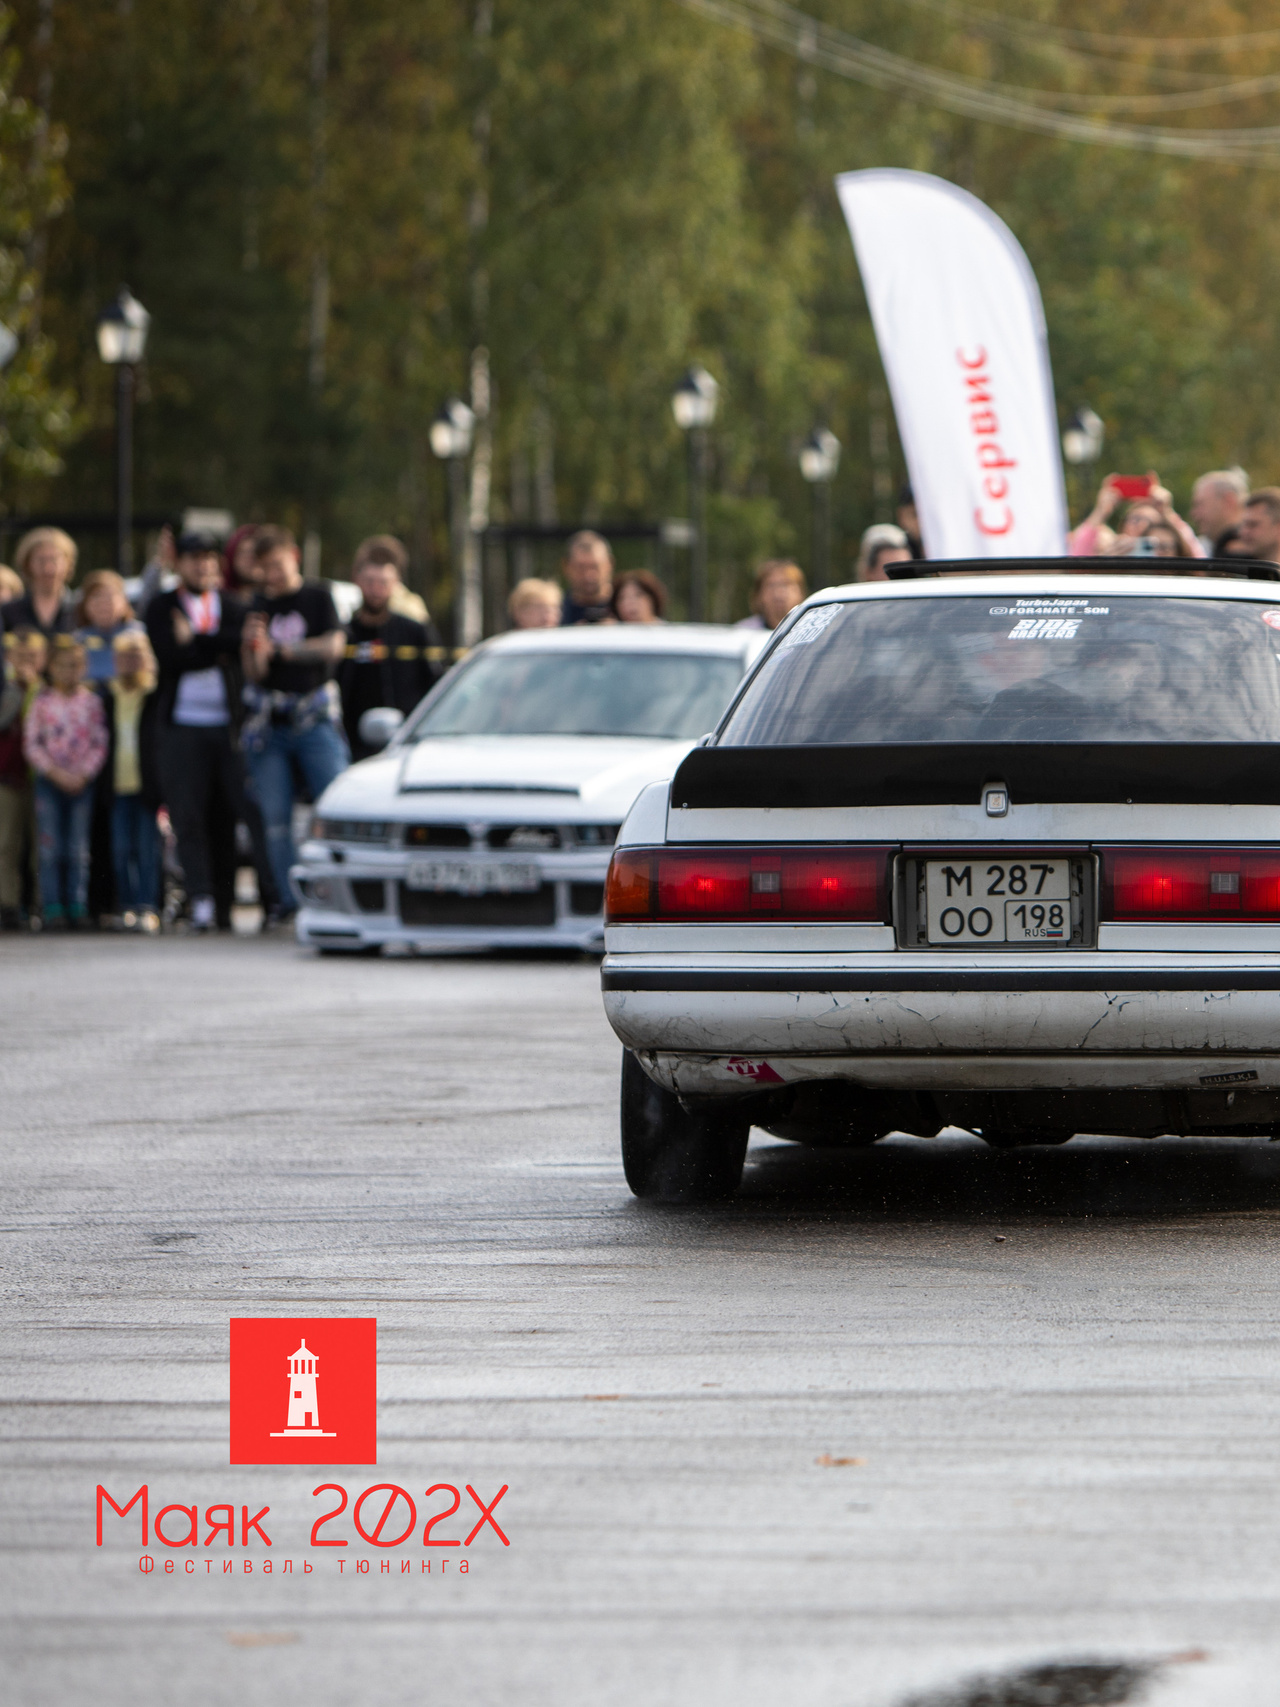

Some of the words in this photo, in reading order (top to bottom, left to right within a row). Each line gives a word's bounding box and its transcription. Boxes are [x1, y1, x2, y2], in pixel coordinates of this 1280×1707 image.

[956, 344, 1017, 538] Сервис
[1015, 599, 1089, 607] TurboJapan
[986, 864, 1049, 896] 287
[1013, 904, 1064, 929] 198
[1024, 928, 1047, 937] RUS
